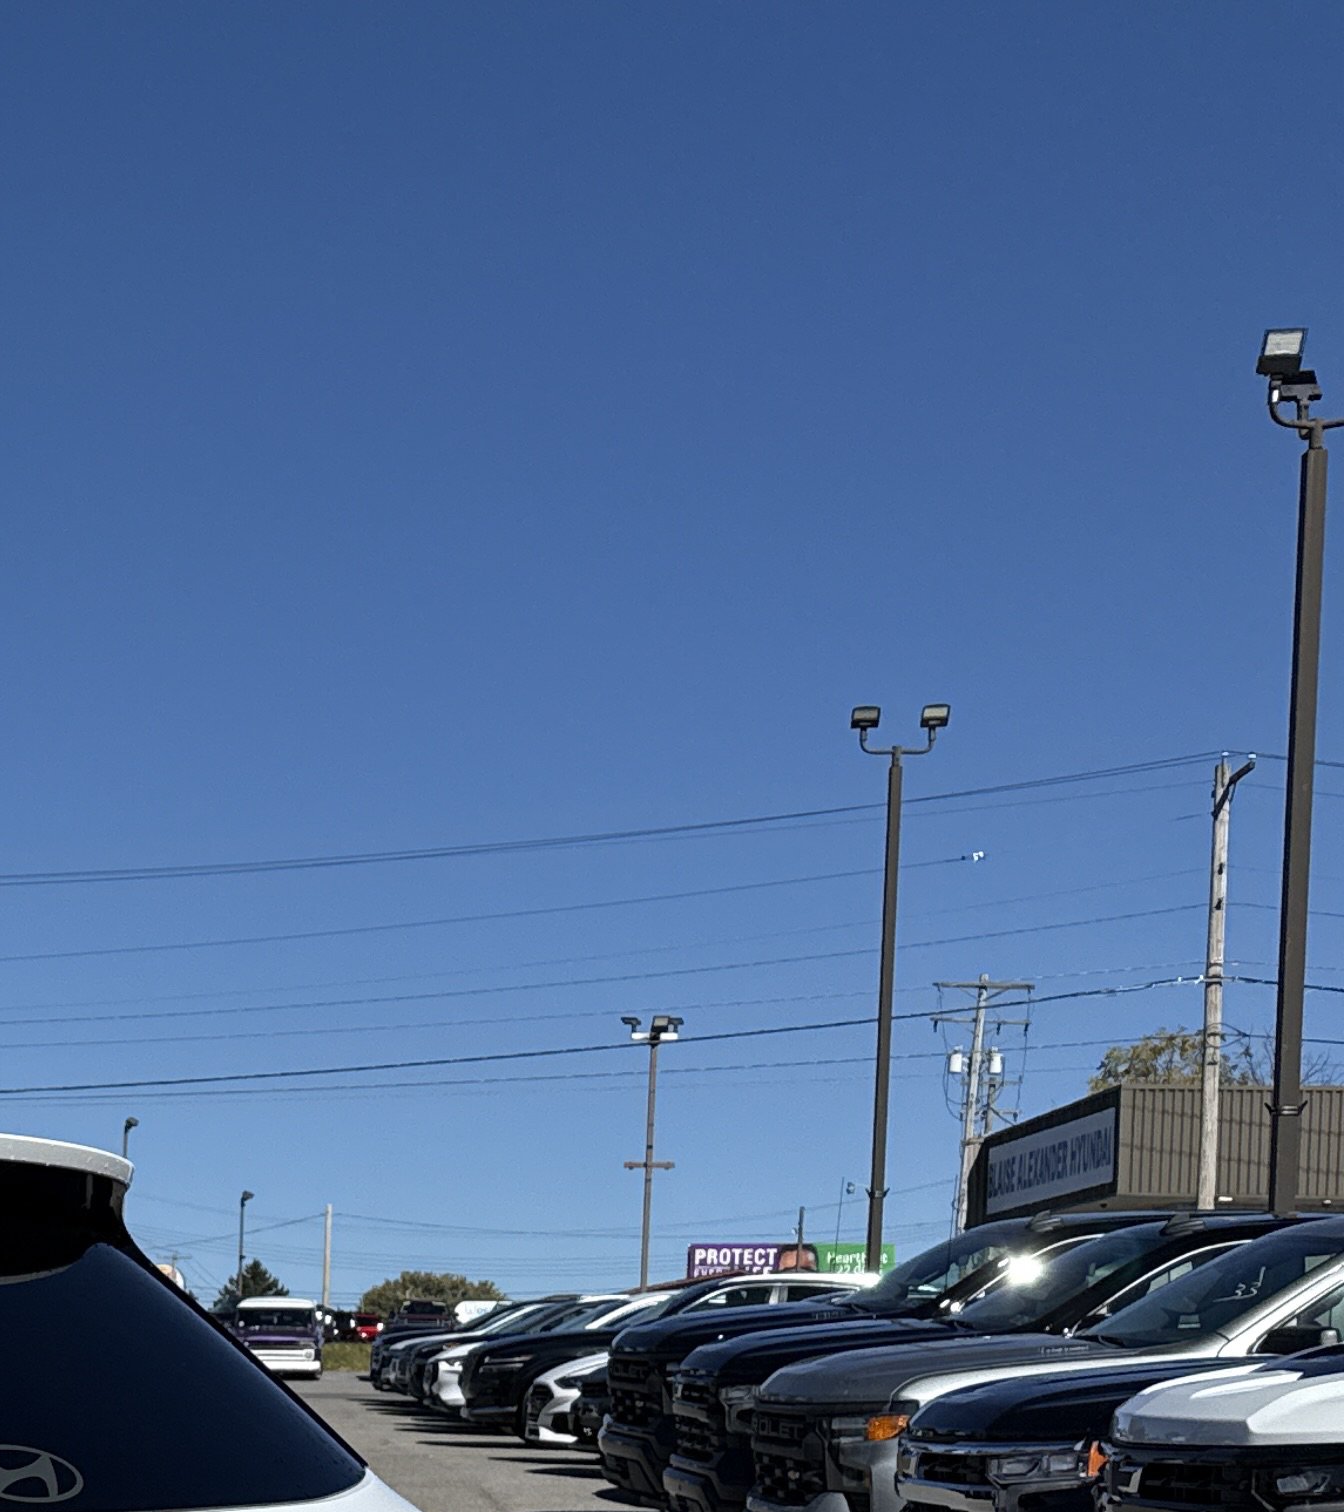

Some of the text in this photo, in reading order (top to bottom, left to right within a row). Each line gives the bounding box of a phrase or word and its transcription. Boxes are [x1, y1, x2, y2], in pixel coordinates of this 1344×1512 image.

[987, 1126, 1113, 1199] BLAISE ALEXANDER HYUNDAI
[694, 1248, 777, 1265] PROTECT
